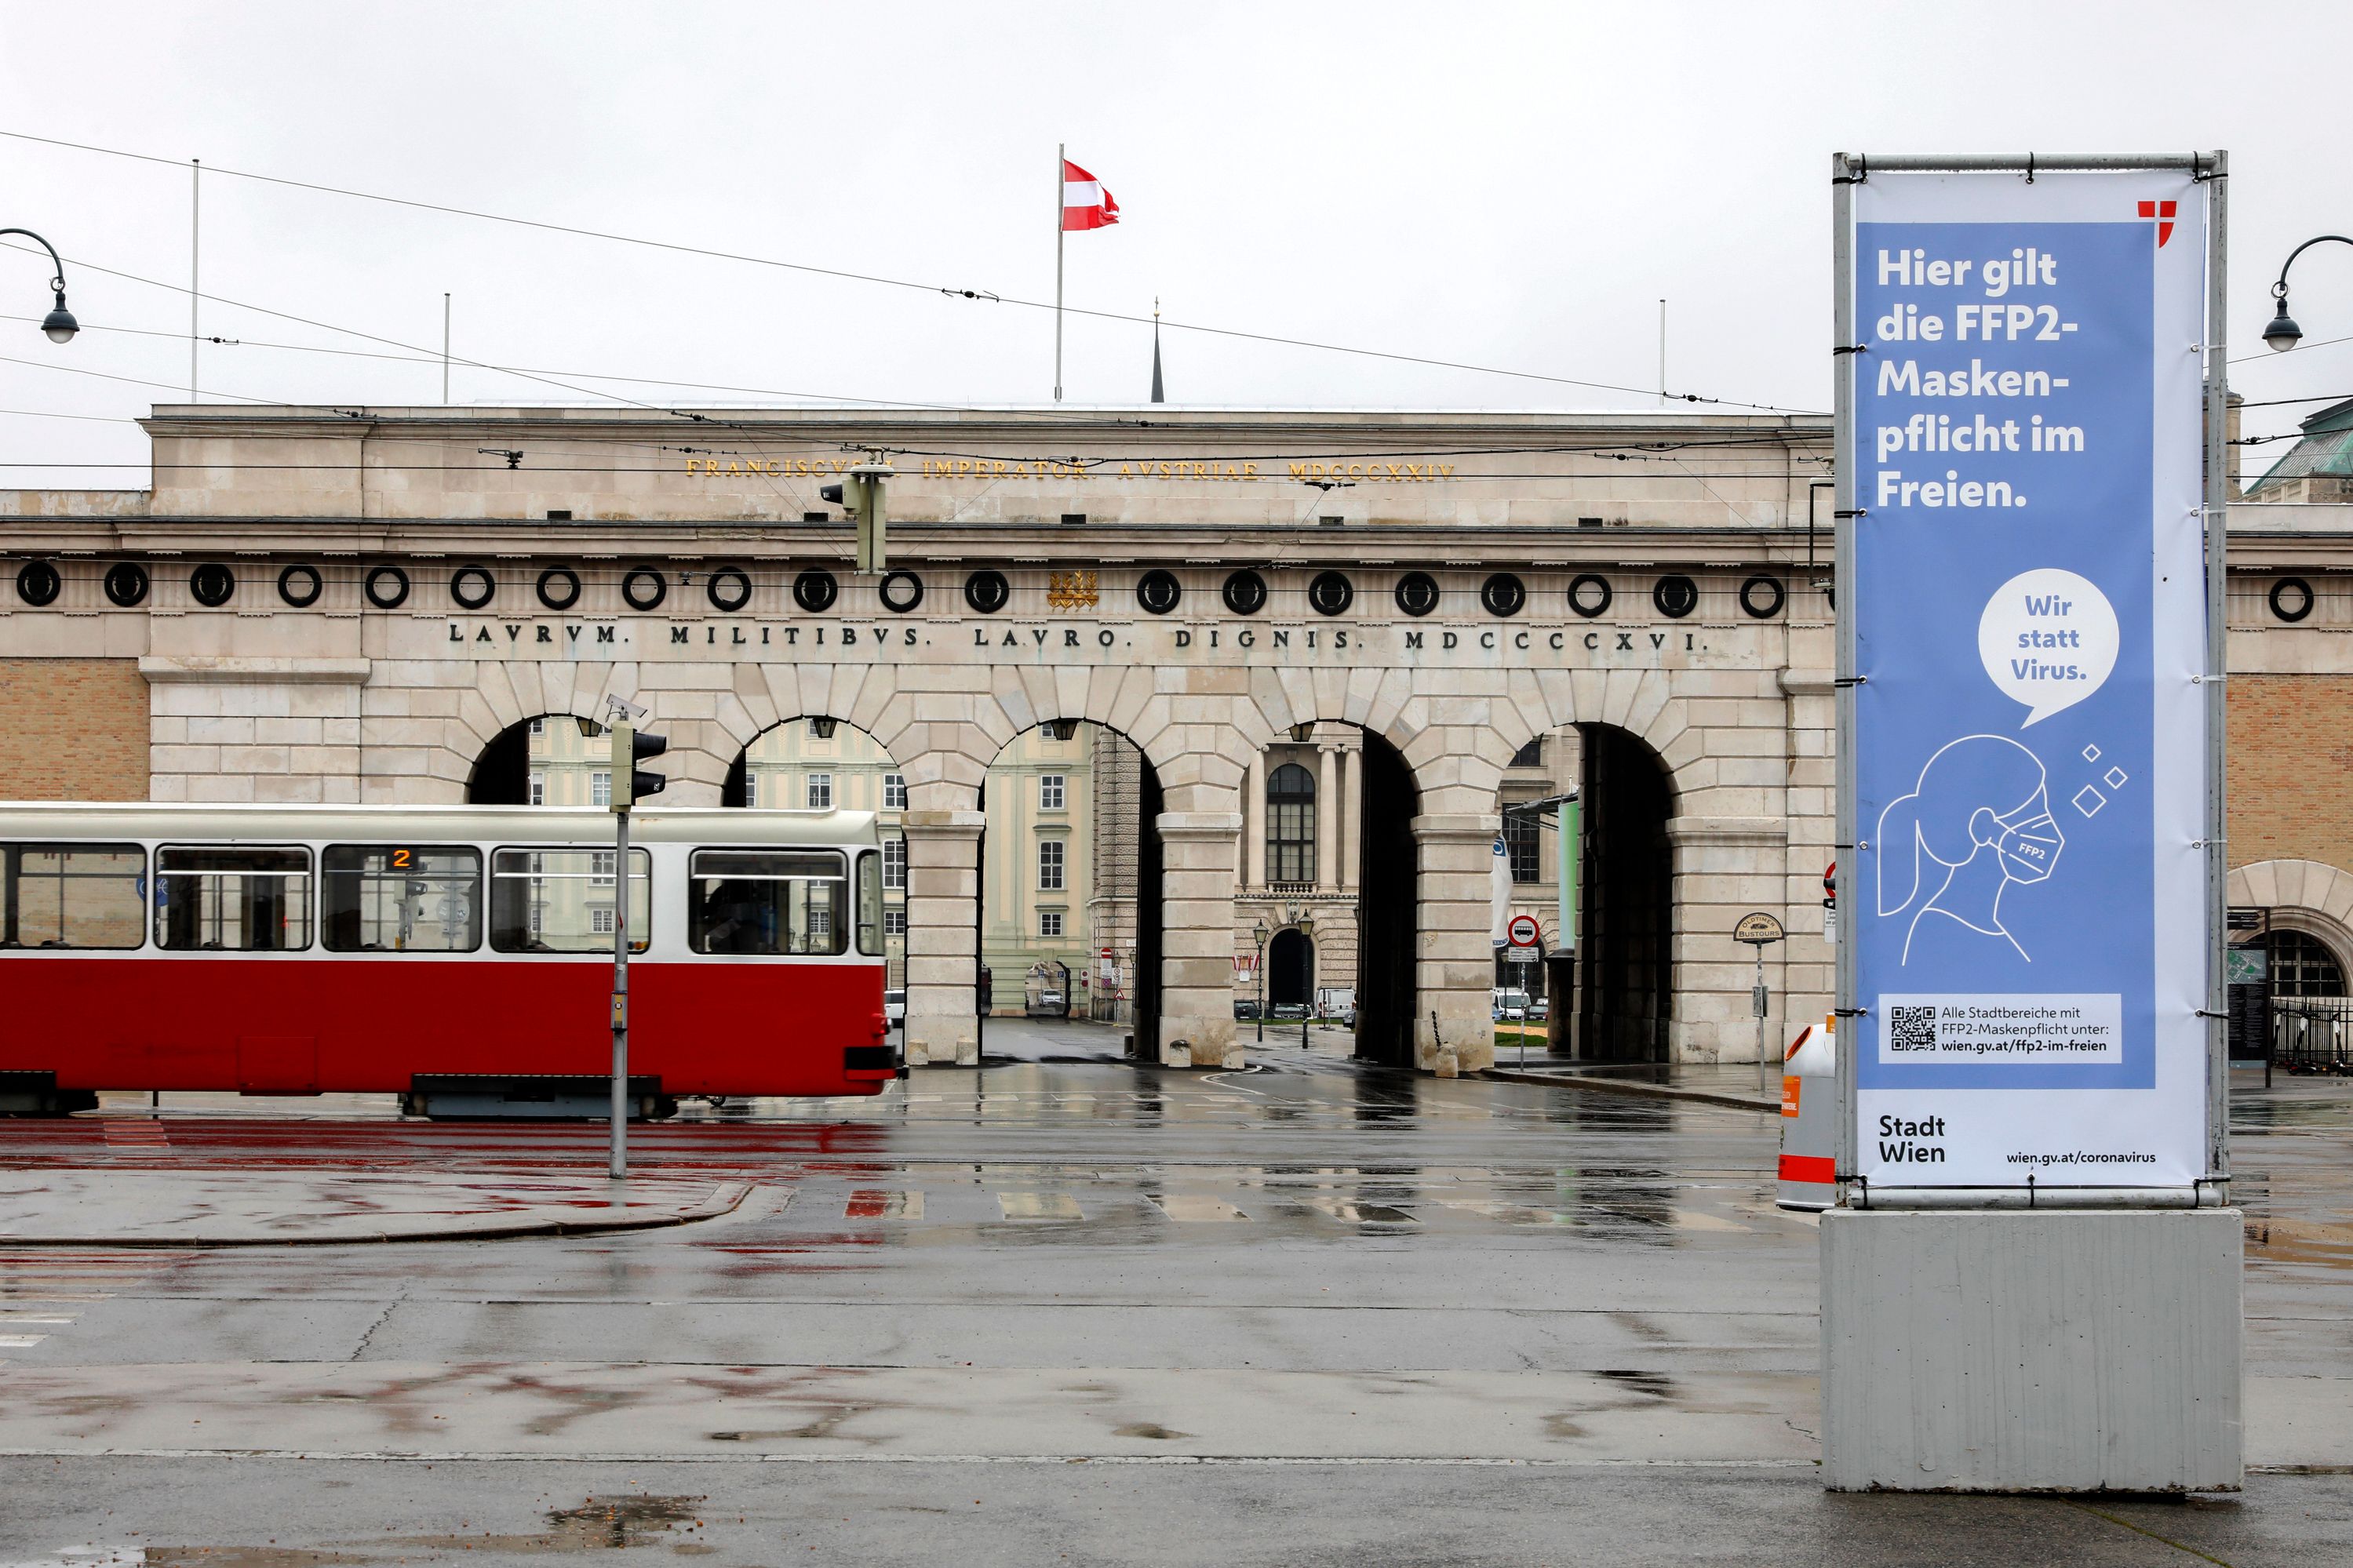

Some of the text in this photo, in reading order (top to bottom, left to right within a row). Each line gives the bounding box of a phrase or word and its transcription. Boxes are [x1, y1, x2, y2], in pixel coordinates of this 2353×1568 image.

[1878, 248, 2057, 297] Hier gilt
[1877, 304, 2078, 341] die FFP2-
[1877, 358, 2070, 397] Masken-
[1878, 413, 2085, 464] pflicht im
[922, 460, 1098, 479] IMPERATOR.
[1118, 462, 1267, 481] AVSTRIAE.
[1288, 464, 1462, 482] MDCCCXXIV.
[1878, 470, 2027, 508] Freien.
[2025, 595, 2072, 617] Wir
[450, 624, 1708, 651] LAVRVM. MILITIBVS. LAVRO. DIGNIS. MDCCCCXVI.
[2018, 630, 2080, 649] statt
[2011, 659, 2087, 681] Virus.
[394, 849, 410, 867] 2
[2019, 842, 2045, 860] FFP2
[1742, 916, 1776, 928] OLDTIMER
[1941, 1006, 2081, 1019] Alle Stadtbereiche mit
[1941, 1023, 2110, 1038] FFP2-Maskenpflicht unter:
[1941, 1039, 2107, 1055] wien.gv.at/ffp2-im-freien
[1878, 1115, 1946, 1137] Stadt
[1878, 1141, 1946, 1164] Wien
[2006, 1150, 2157, 1166] wien.gv.at/coronavirus
